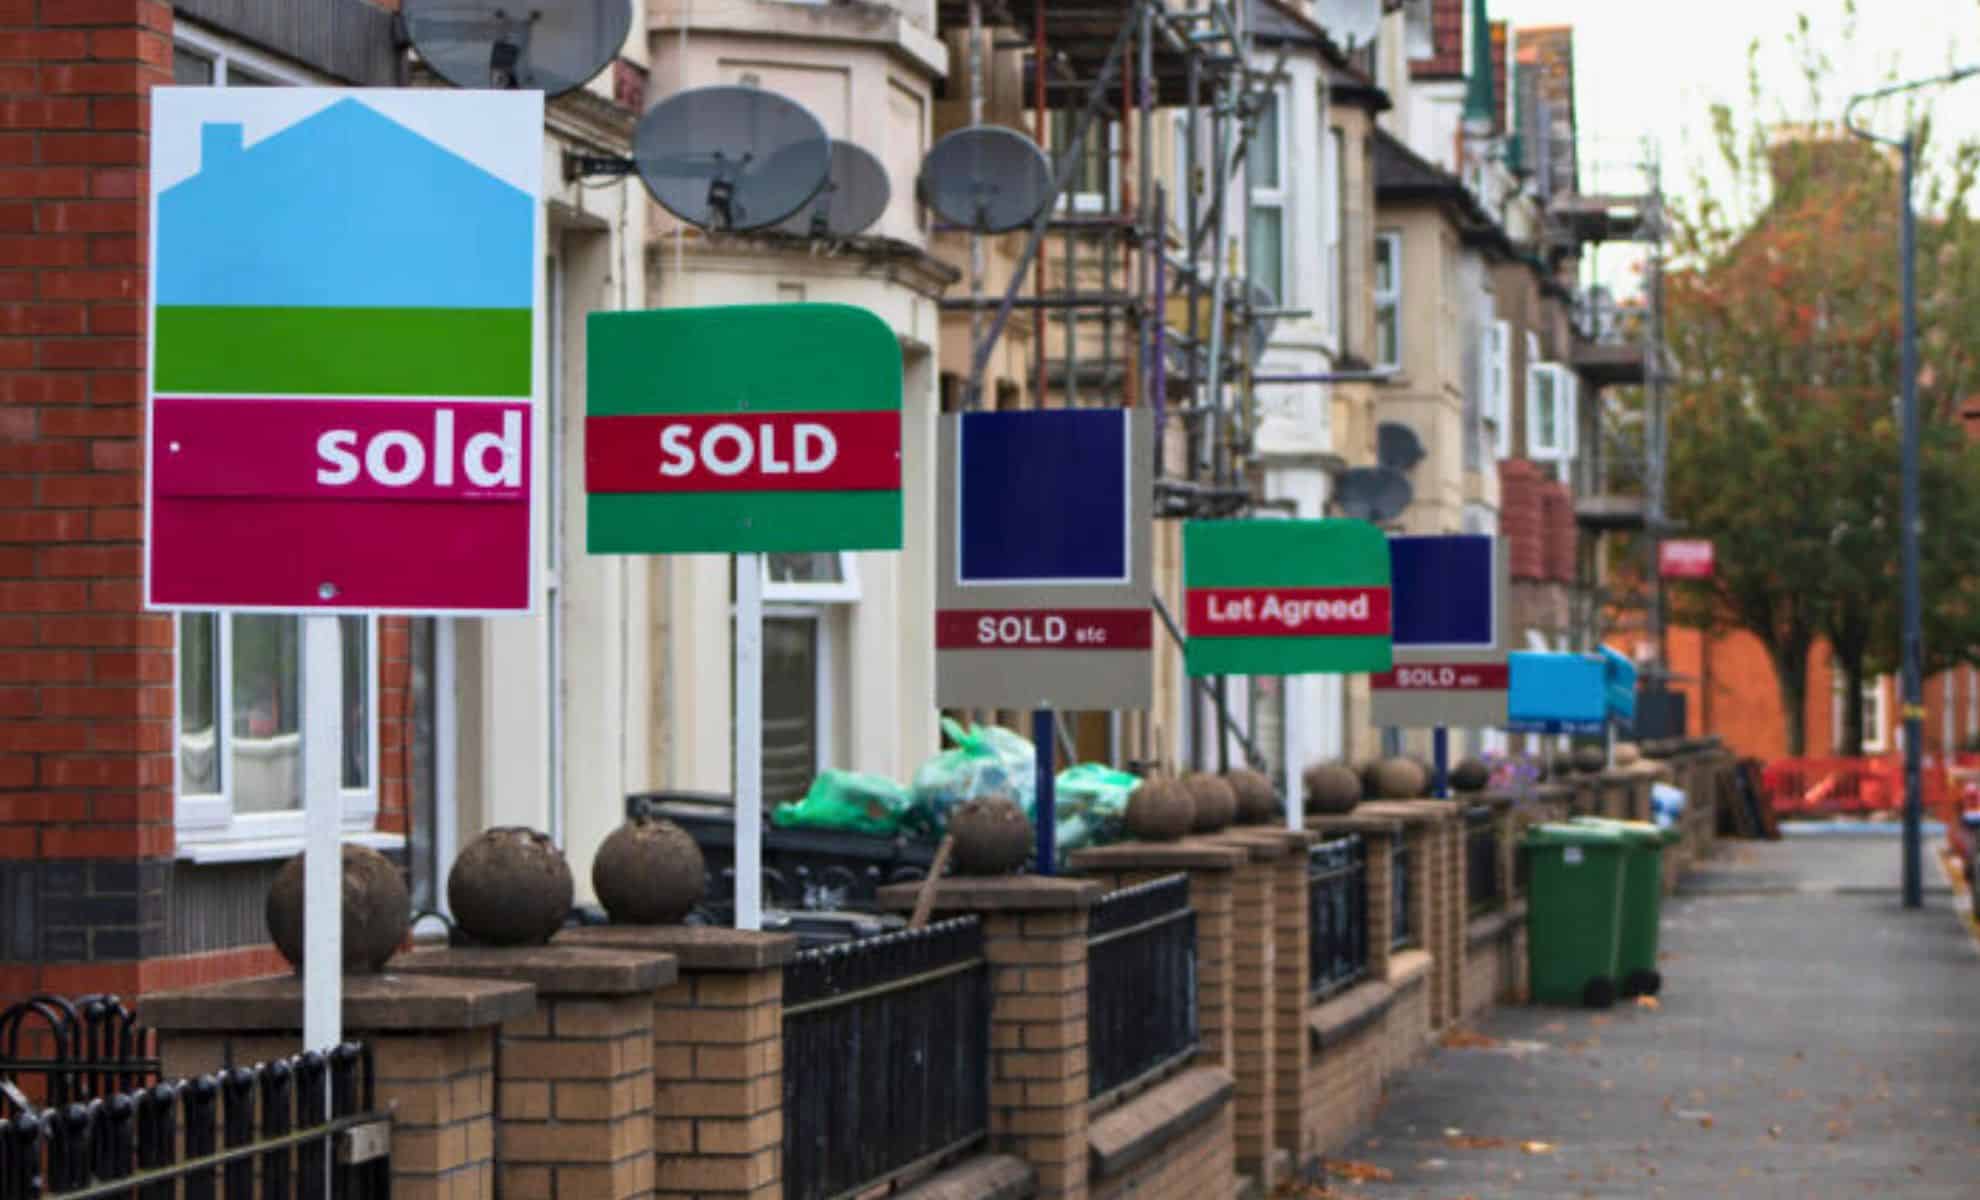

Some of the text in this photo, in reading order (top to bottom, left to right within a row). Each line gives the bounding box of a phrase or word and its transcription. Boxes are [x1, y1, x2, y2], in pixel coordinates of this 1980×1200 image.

[316, 409, 523, 487] sold
[660, 423, 837, 476] SOLD
[1207, 594, 1369, 627] Let Agreed
[977, 616, 1067, 643] SOLD
[1396, 667, 1455, 687] SOLD
